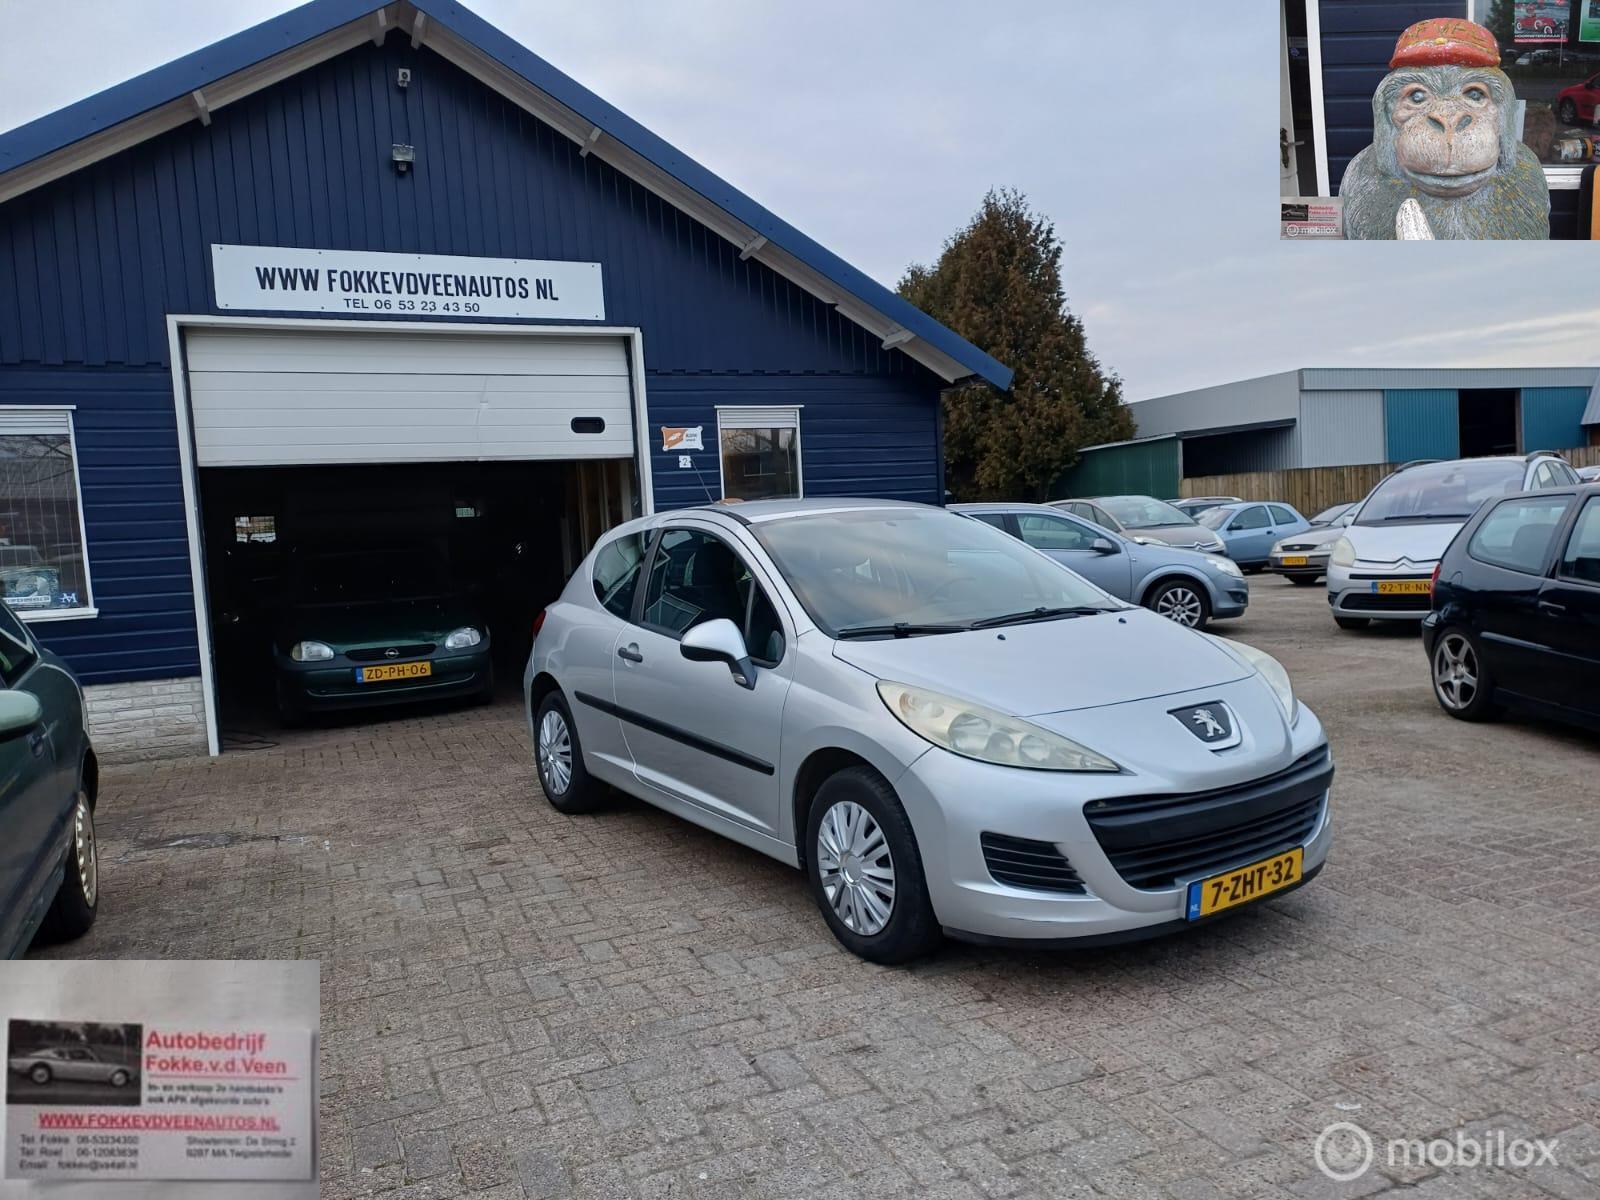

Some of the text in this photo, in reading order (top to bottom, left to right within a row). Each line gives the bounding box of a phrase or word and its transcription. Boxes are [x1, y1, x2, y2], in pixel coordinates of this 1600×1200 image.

[255, 266, 559, 301] WWW FOKKEVDVEENAUTOS NL
[344, 298, 480, 312] TEL 06 53 23 43 50
[366, 664, 427, 680] ZD-PH-06
[1211, 856, 1294, 907] 7-ZHT-32
